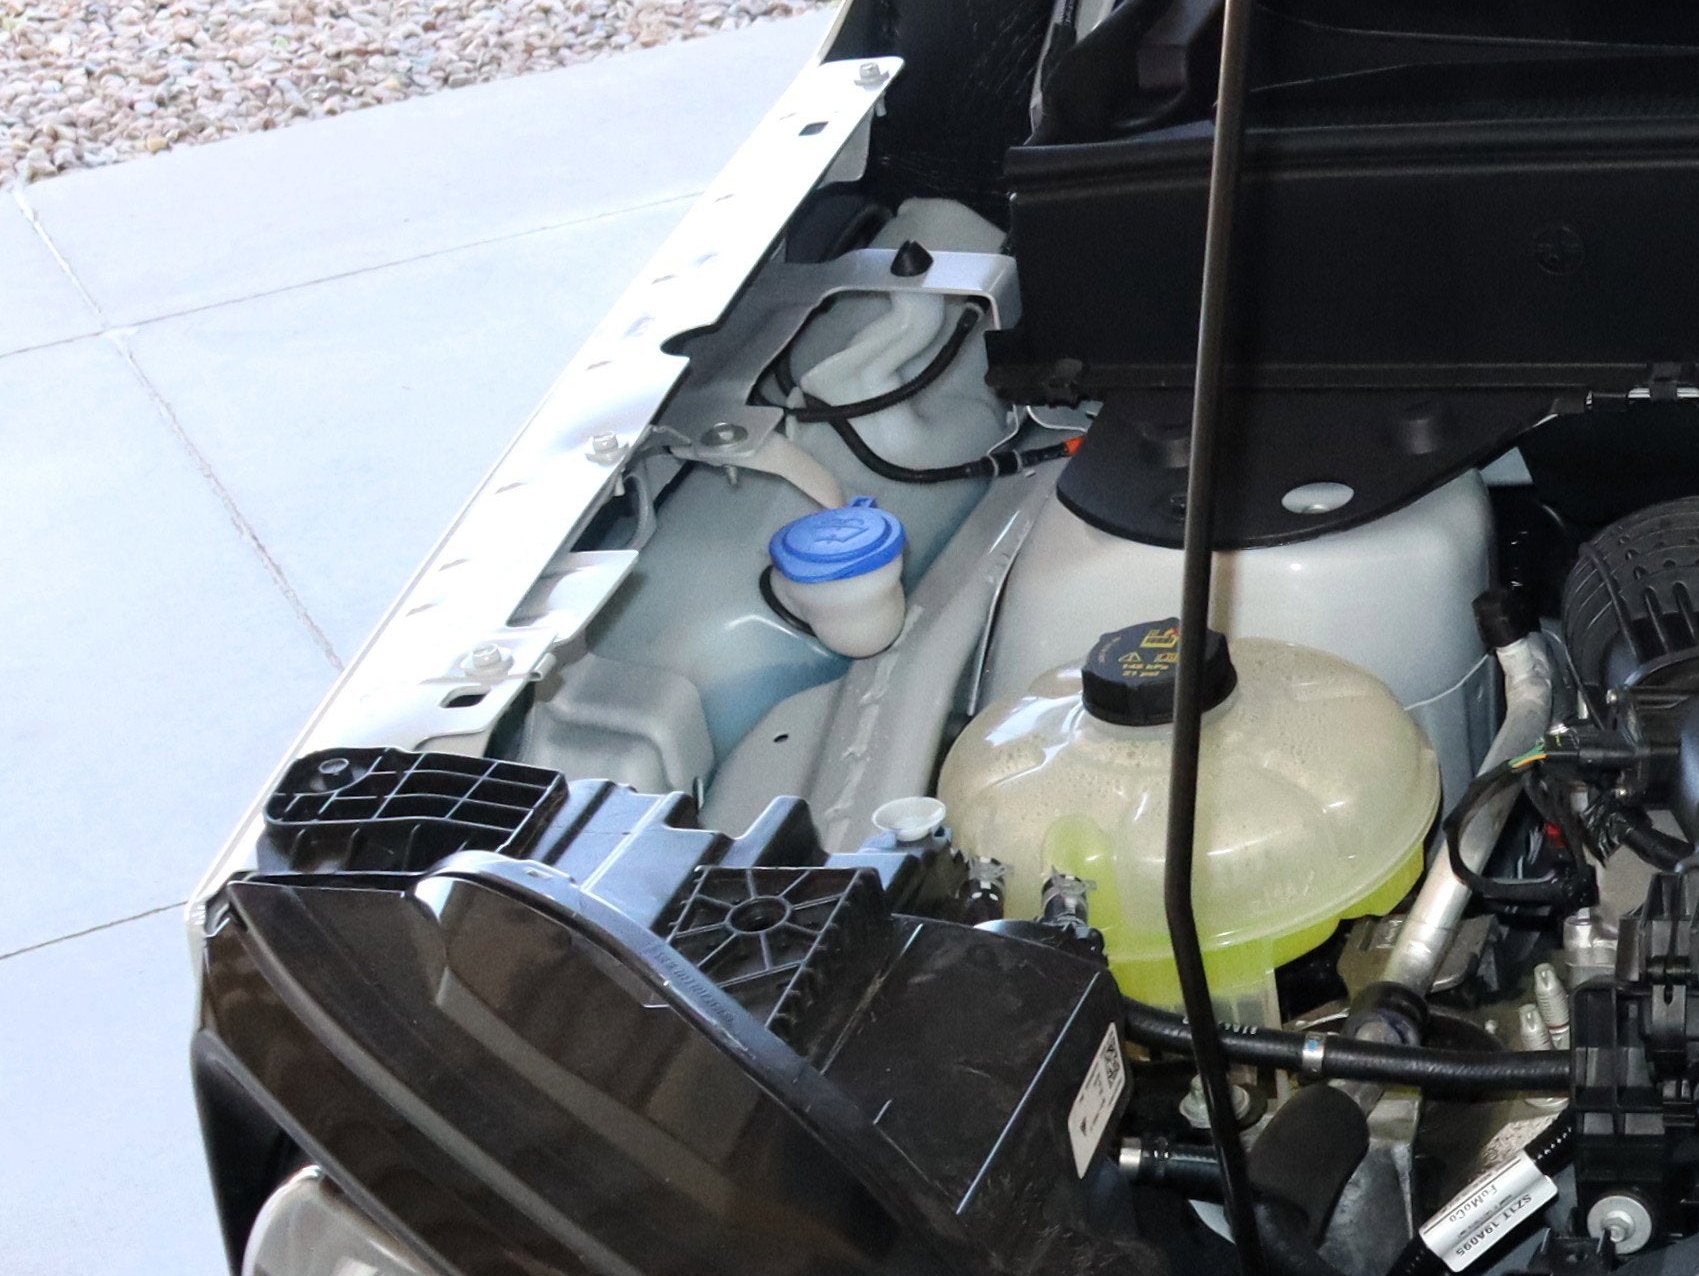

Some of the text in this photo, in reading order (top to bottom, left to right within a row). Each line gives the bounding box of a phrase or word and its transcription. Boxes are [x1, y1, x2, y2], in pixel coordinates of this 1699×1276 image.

[1448, 1184, 1498, 1223] FoMoCo
[1503, 1193, 1533, 1221] SZ1T
[1455, 1218, 1500, 1257] 19A095
